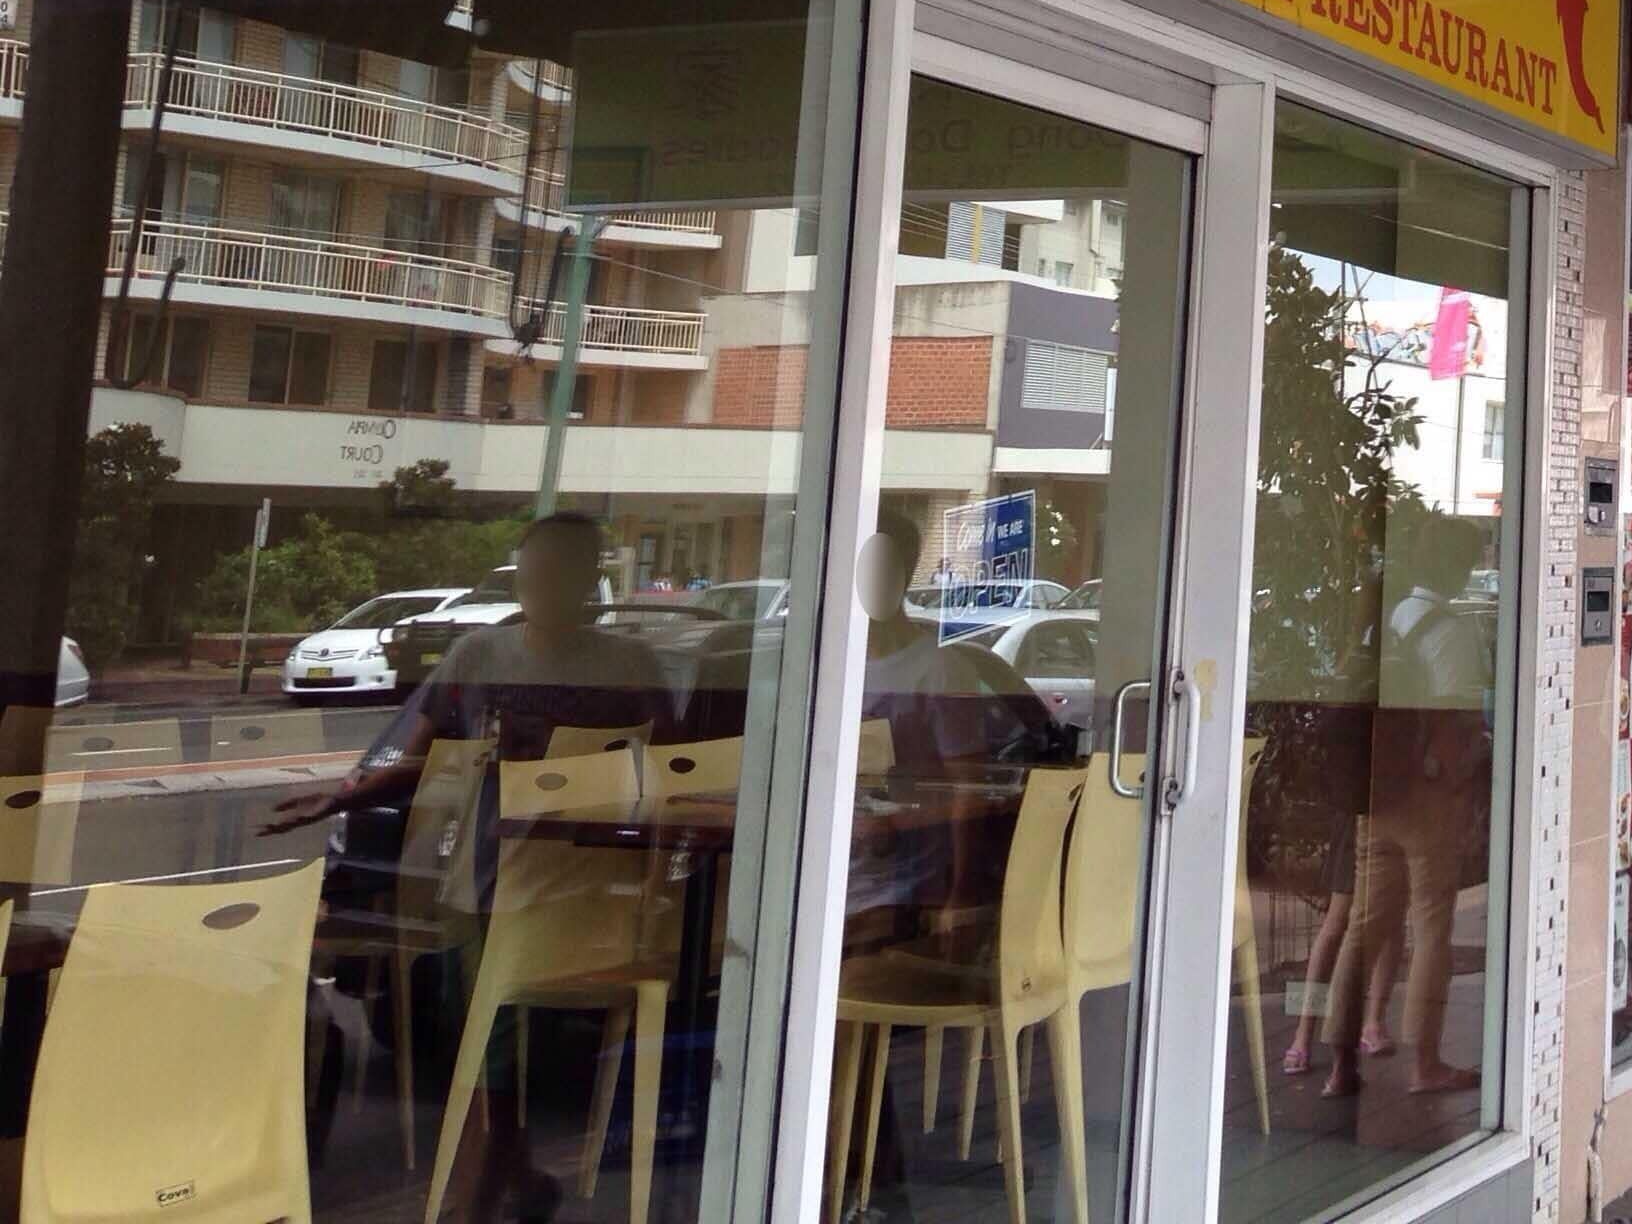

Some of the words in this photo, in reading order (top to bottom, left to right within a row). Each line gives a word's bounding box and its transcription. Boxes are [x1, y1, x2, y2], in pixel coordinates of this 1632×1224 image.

[997, 523, 1009, 539] WE
[1009, 519, 1024, 537] ARE
[947, 548, 1029, 620] OPEN
